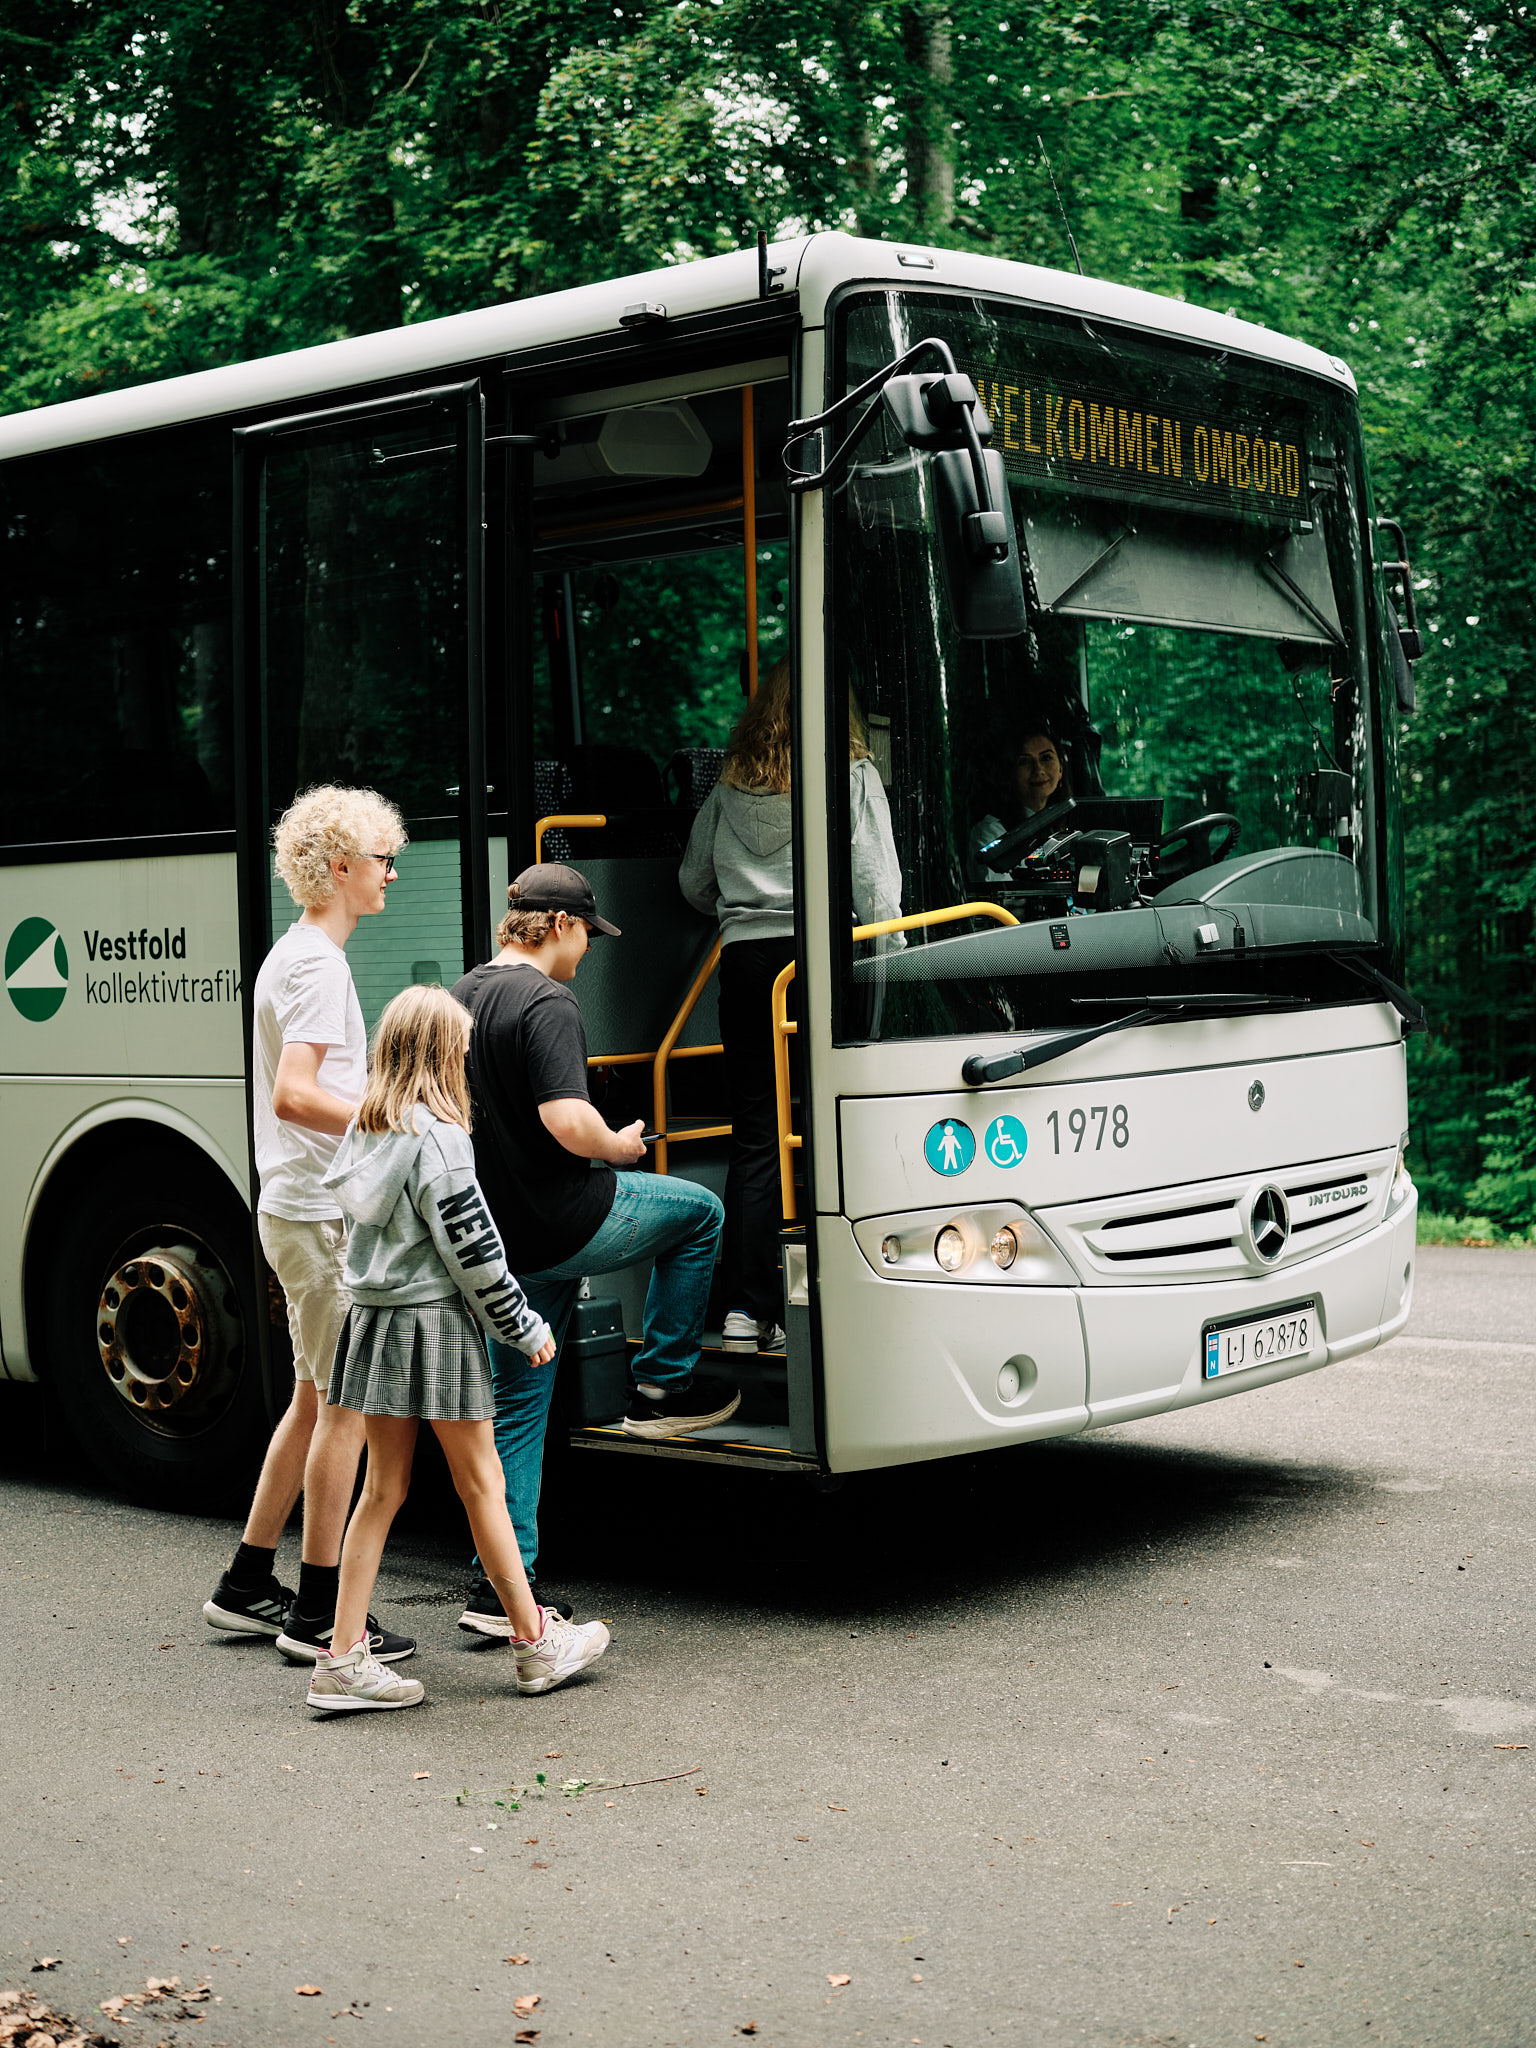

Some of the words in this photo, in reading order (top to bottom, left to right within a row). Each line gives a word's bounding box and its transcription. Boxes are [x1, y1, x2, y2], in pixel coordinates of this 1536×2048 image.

[978, 379, 1182, 477] VELKOMMEN
[1194, 425, 1300, 498] OMBORD
[84, 927, 186, 961] Vestfold
[86, 969, 242, 1004] kollektivtrafik
[1047, 1104, 1130, 1155] 1978
[1309, 1185, 1368, 1207] INTOURO
[437, 1184, 503, 1270] NEW
[1226, 1333, 1245, 1366] LJ
[1254, 1318, 1308, 1359] 62878
[1210, 1360, 1216, 1370] N
